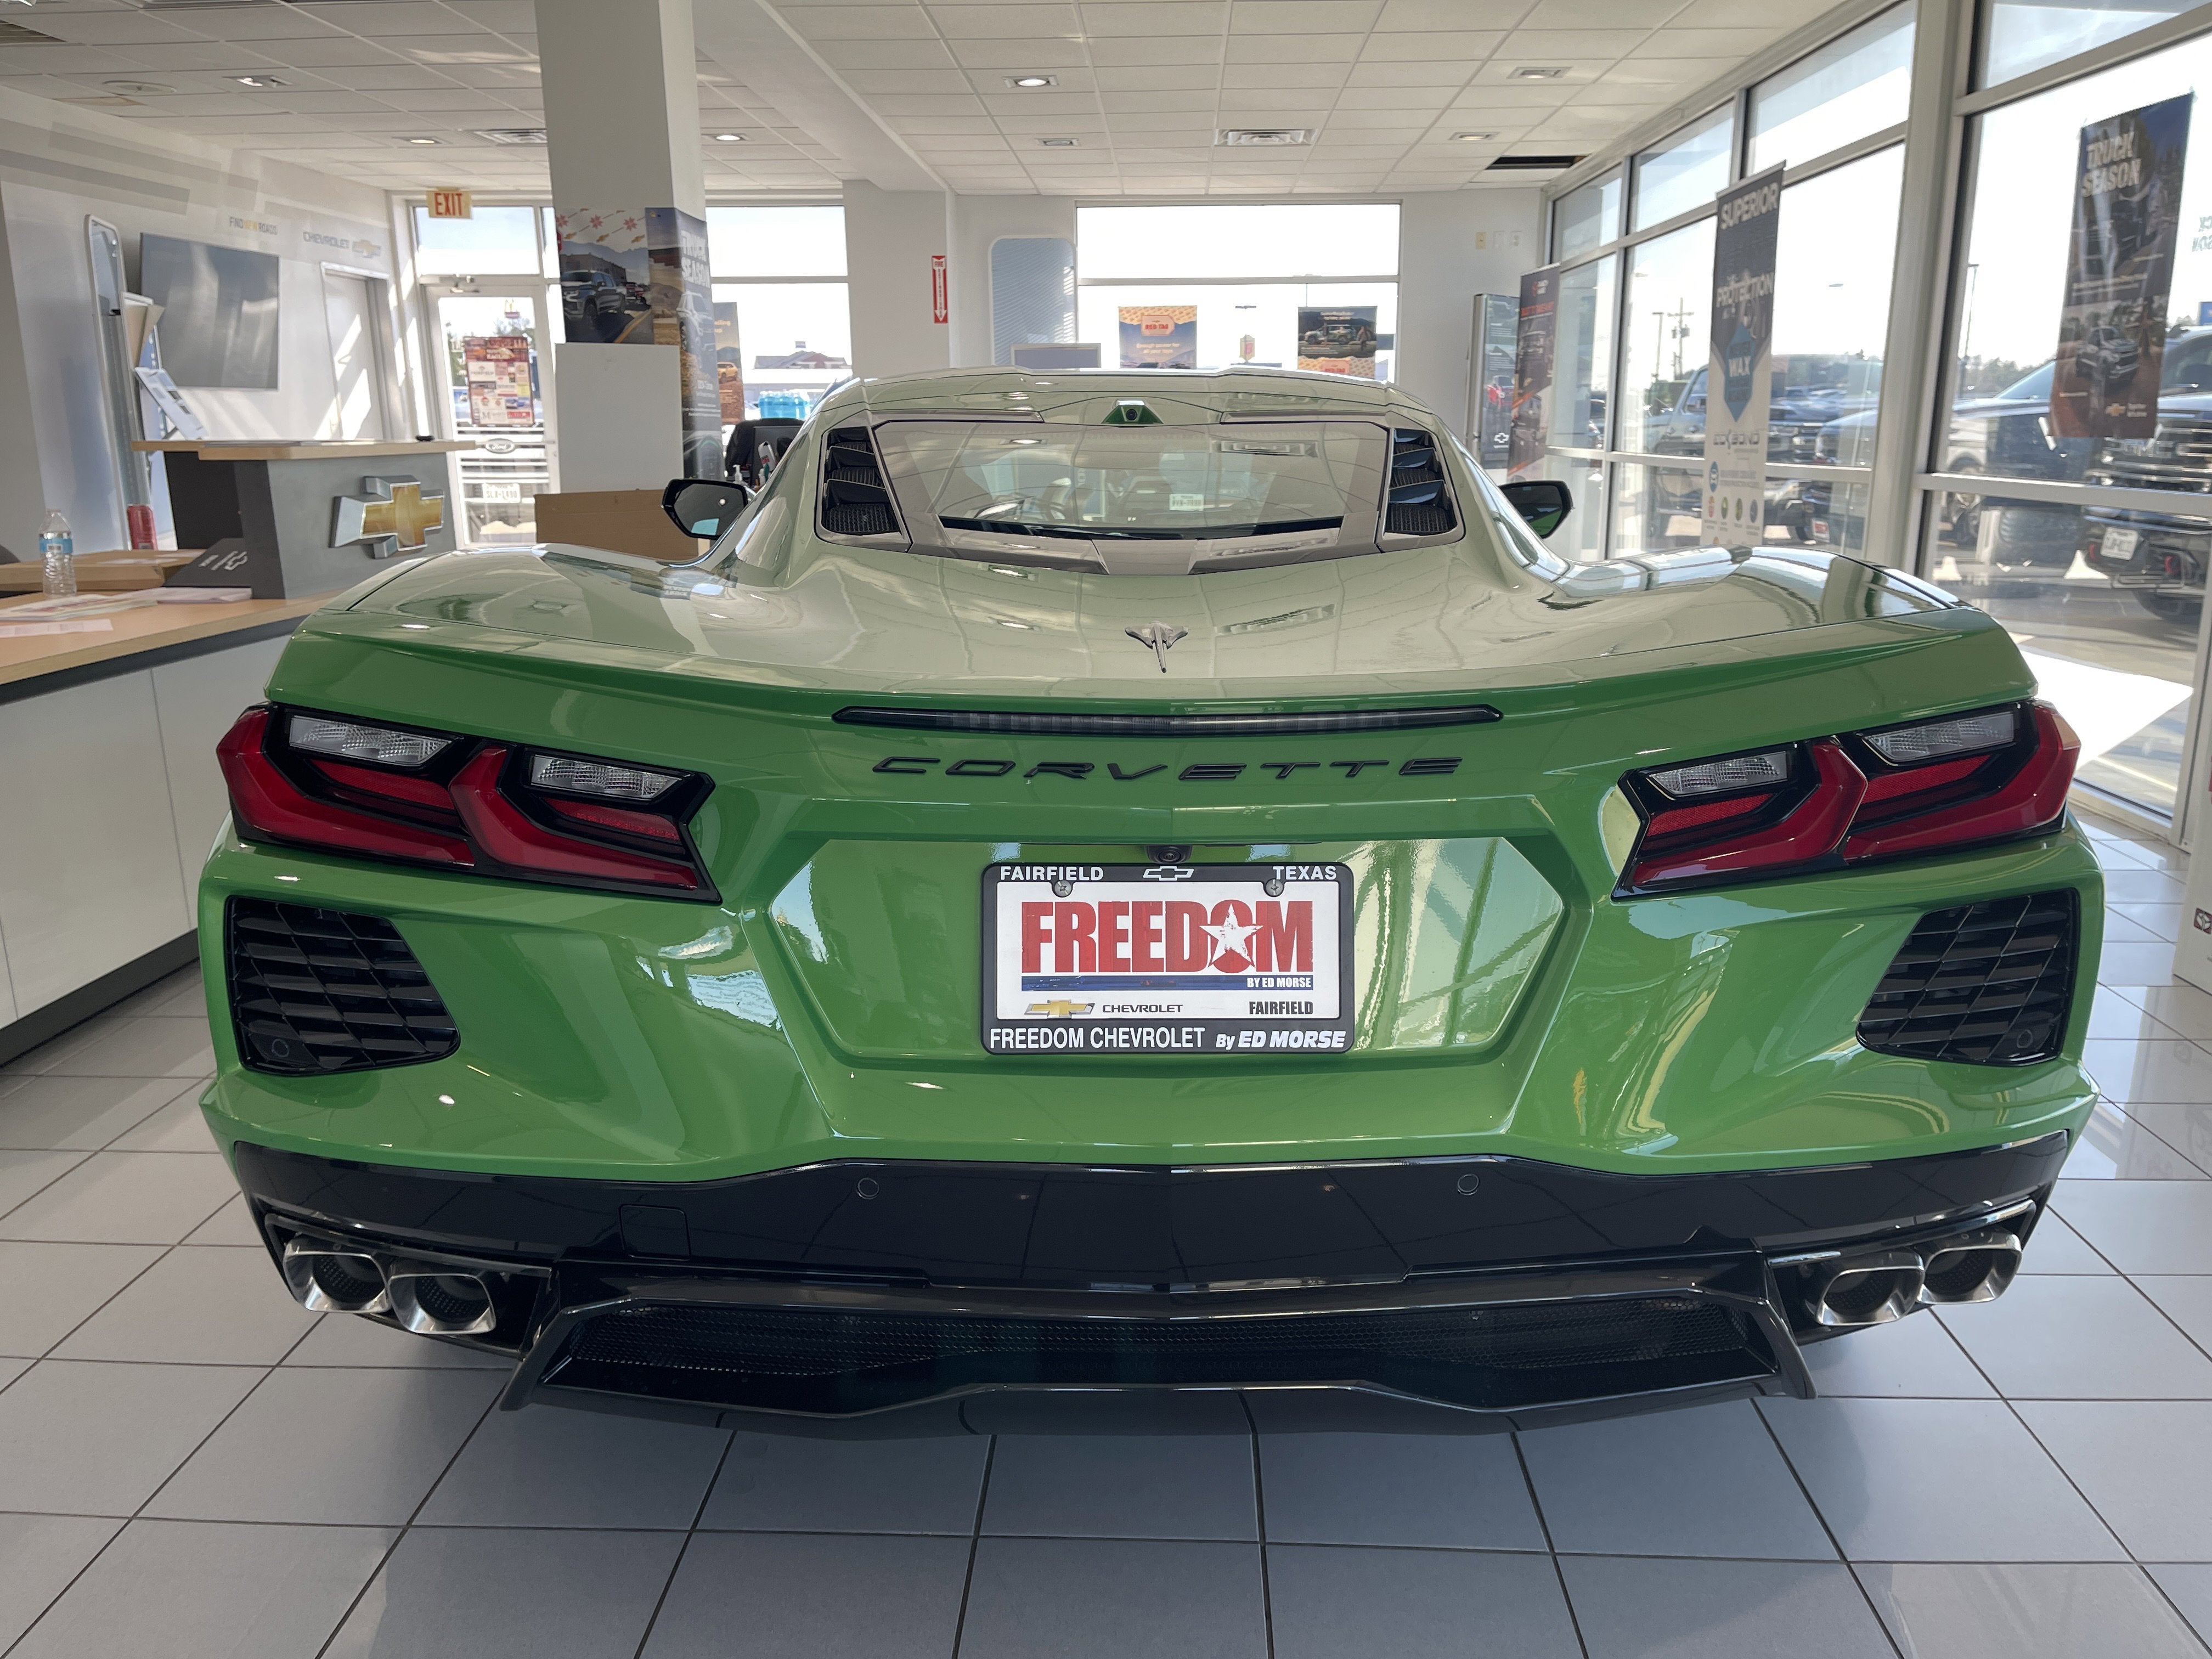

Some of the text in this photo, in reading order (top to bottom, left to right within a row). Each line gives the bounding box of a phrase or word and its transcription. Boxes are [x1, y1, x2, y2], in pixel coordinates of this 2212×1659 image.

[2082, 158, 2142, 198] SEASON
[434, 193, 462, 216] EXIT
[1720, 182, 1779, 229] SUPERIOR
[1716, 272, 1774, 308] PROTECTION
[1729, 356, 1751, 378] WAX
[873, 756, 1463, 781] CORVETTE
[1000, 866, 1103, 881] FAIRFIELD
[1272, 866, 1337, 880] TEXAS
[1022, 899, 1313, 973] FREEDOM
[1247, 977, 1311, 988] BY ED MORSE
[1102, 1005, 1183, 1013] CHEVROLET
[1249, 1001, 1313, 1014] FAIRFIELD
[990, 1026, 1346, 1050] FREEDOM CHEVROLET By ED MORSE
